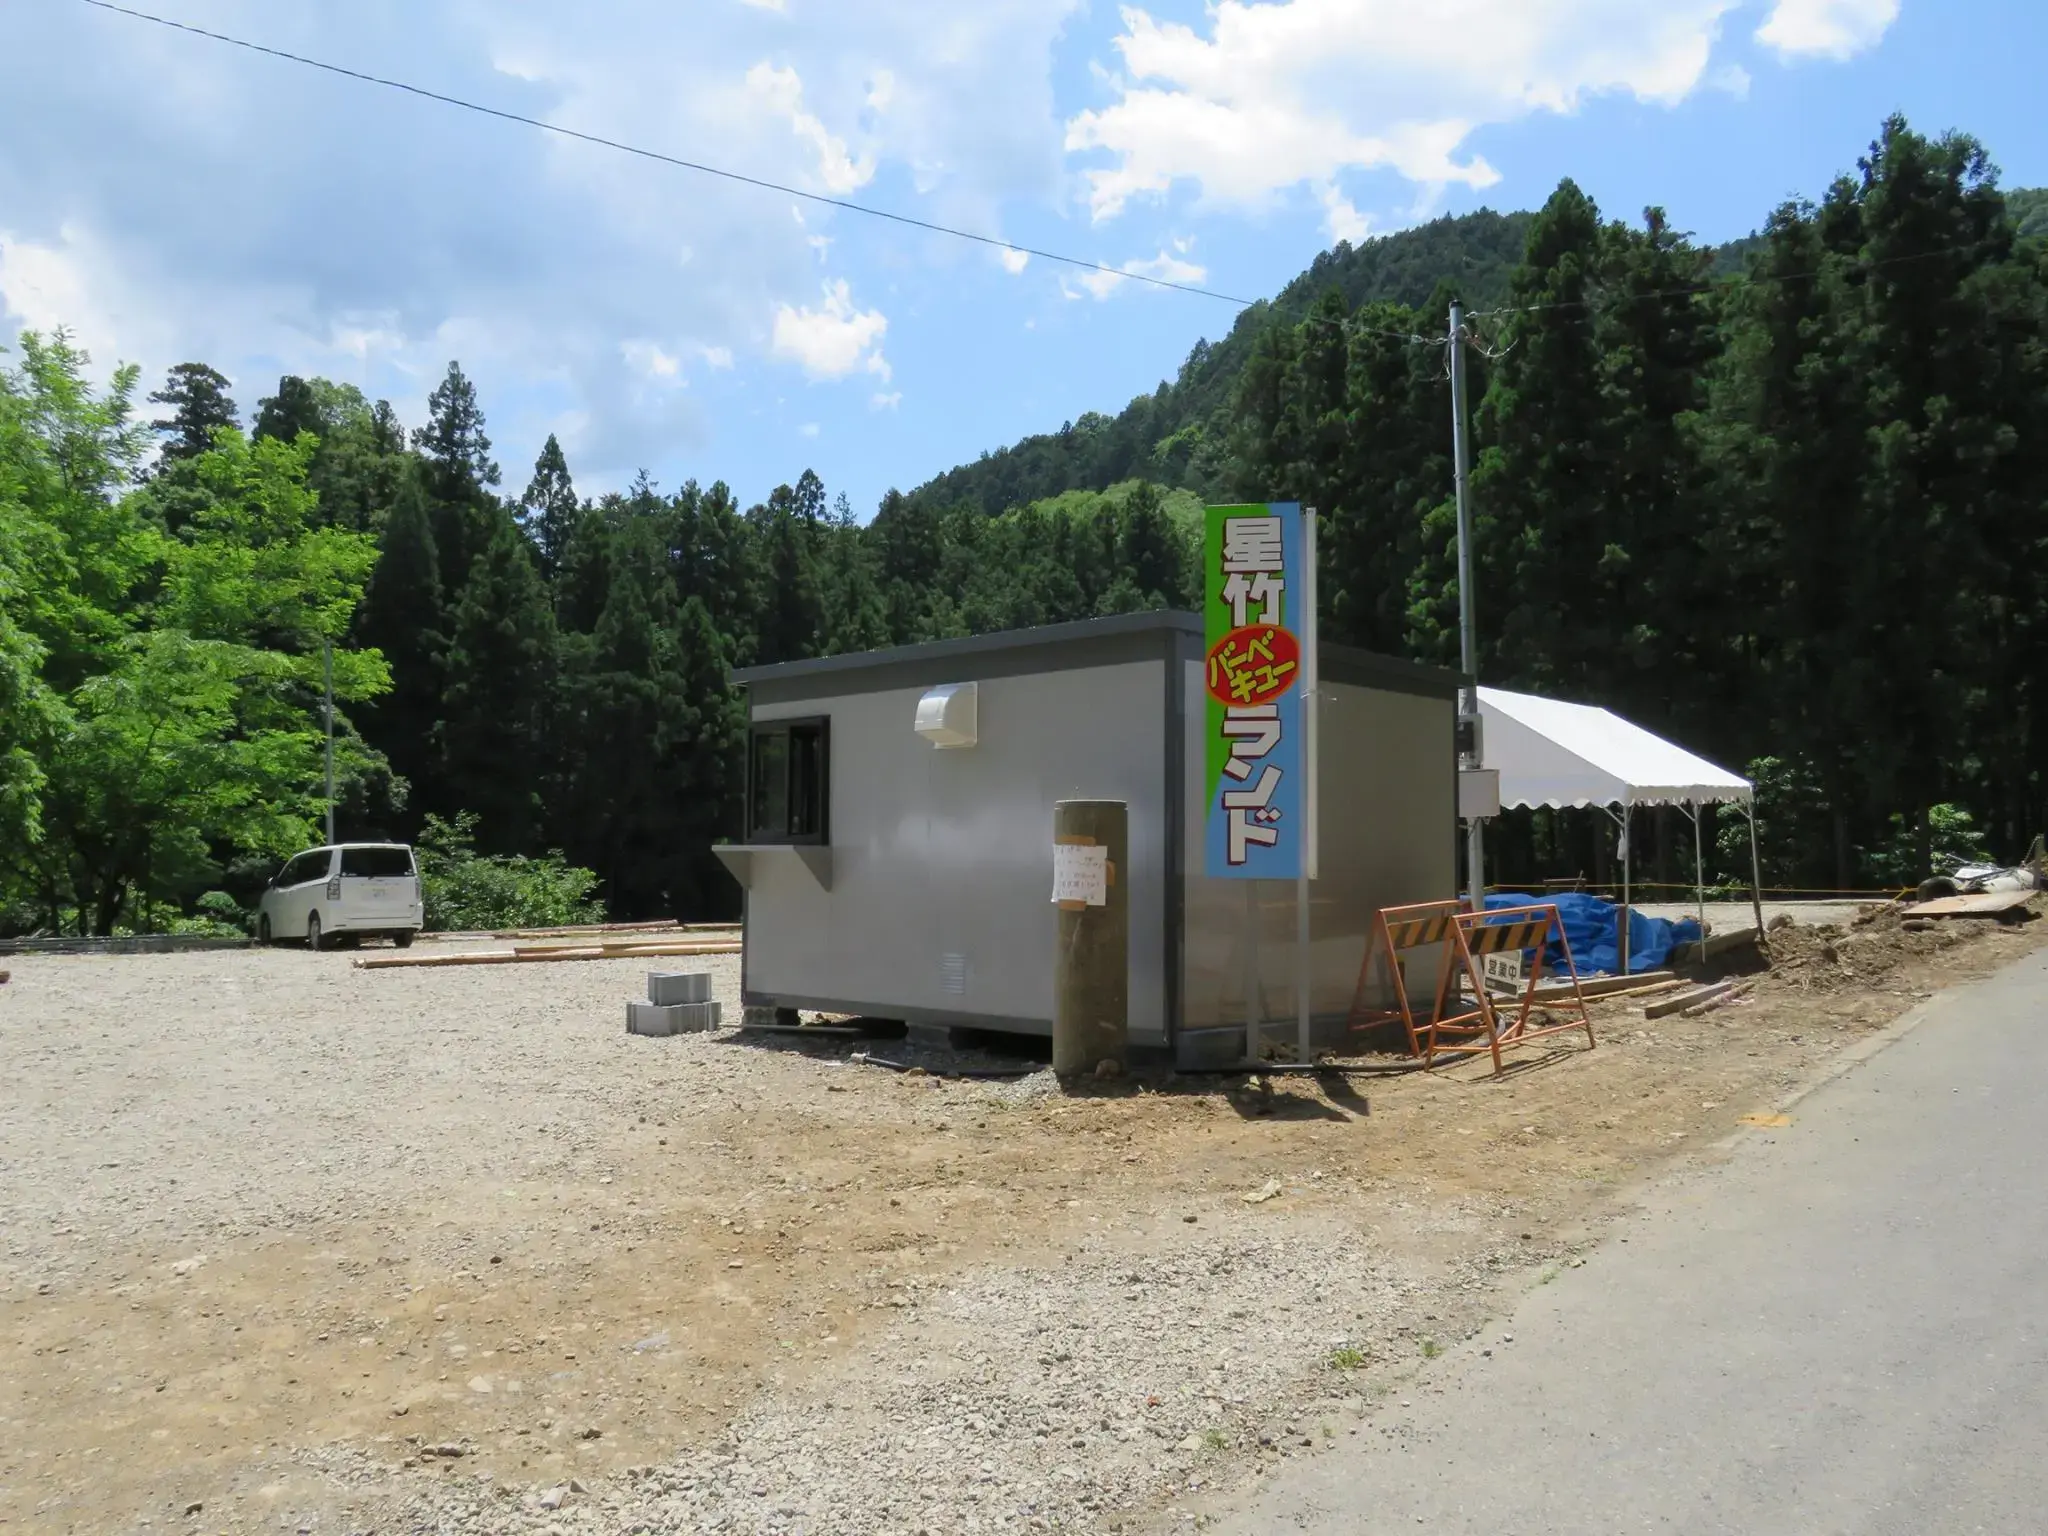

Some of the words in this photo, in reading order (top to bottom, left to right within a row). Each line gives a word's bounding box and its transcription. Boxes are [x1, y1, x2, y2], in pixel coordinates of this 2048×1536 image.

[1222, 516, 1284, 628] 星竹
[1222, 704, 1284, 867] ランド
[1488, 958, 1517, 981] 営業中
